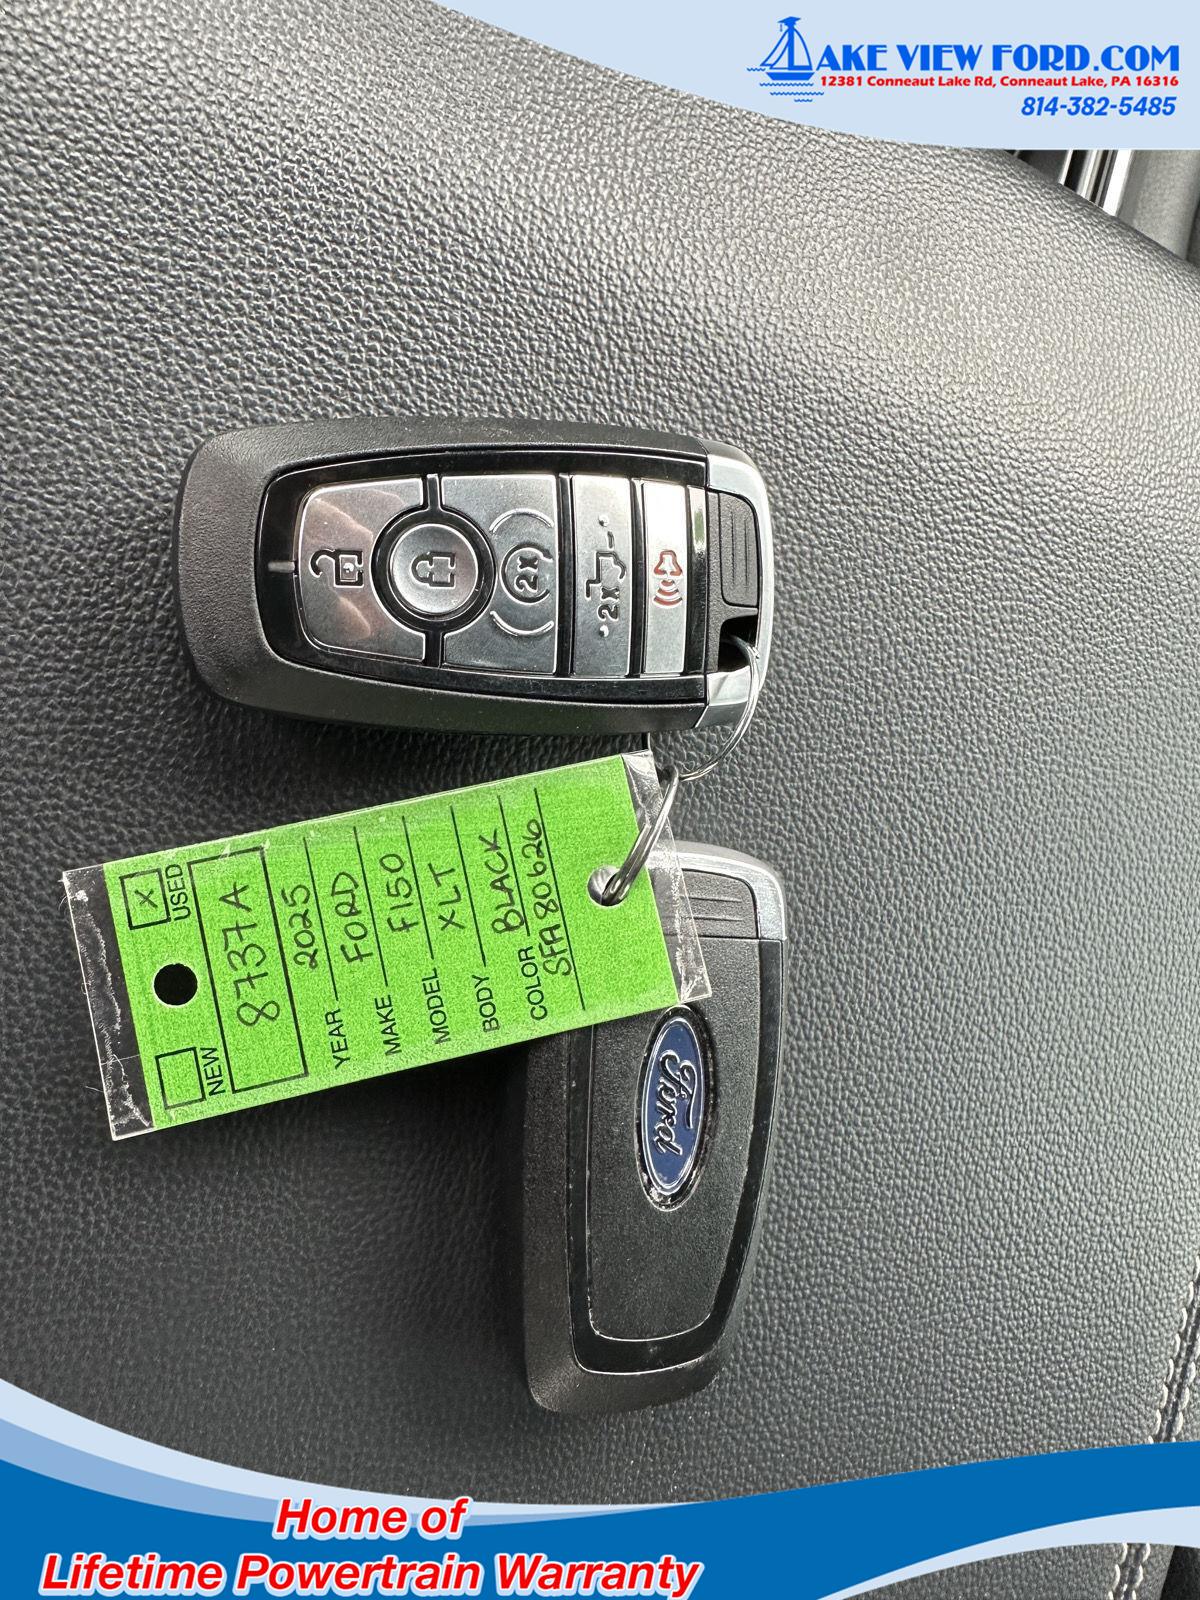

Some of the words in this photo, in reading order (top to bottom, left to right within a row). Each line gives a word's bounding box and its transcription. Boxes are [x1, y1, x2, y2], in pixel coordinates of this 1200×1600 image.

[165, 863, 191, 921] USED
[331, 871, 373, 963] FORD
[379, 853, 419, 933] F150
[428, 862, 465, 930] XLT
[478, 828, 526, 934] BLACK
[219, 881, 281, 1027] 8737A
[281, 884, 318, 970] 2025
[422, 967, 450, 1045] MODEL
[472, 974, 500, 1033] BODY
[518, 945, 548, 1021] COLOR
[325, 1008, 351, 1069] YEAR
[375, 994, 402, 1056] MAKE
[200, 1047, 226, 1097] NEW
[654, 1050, 698, 1156] Ford
